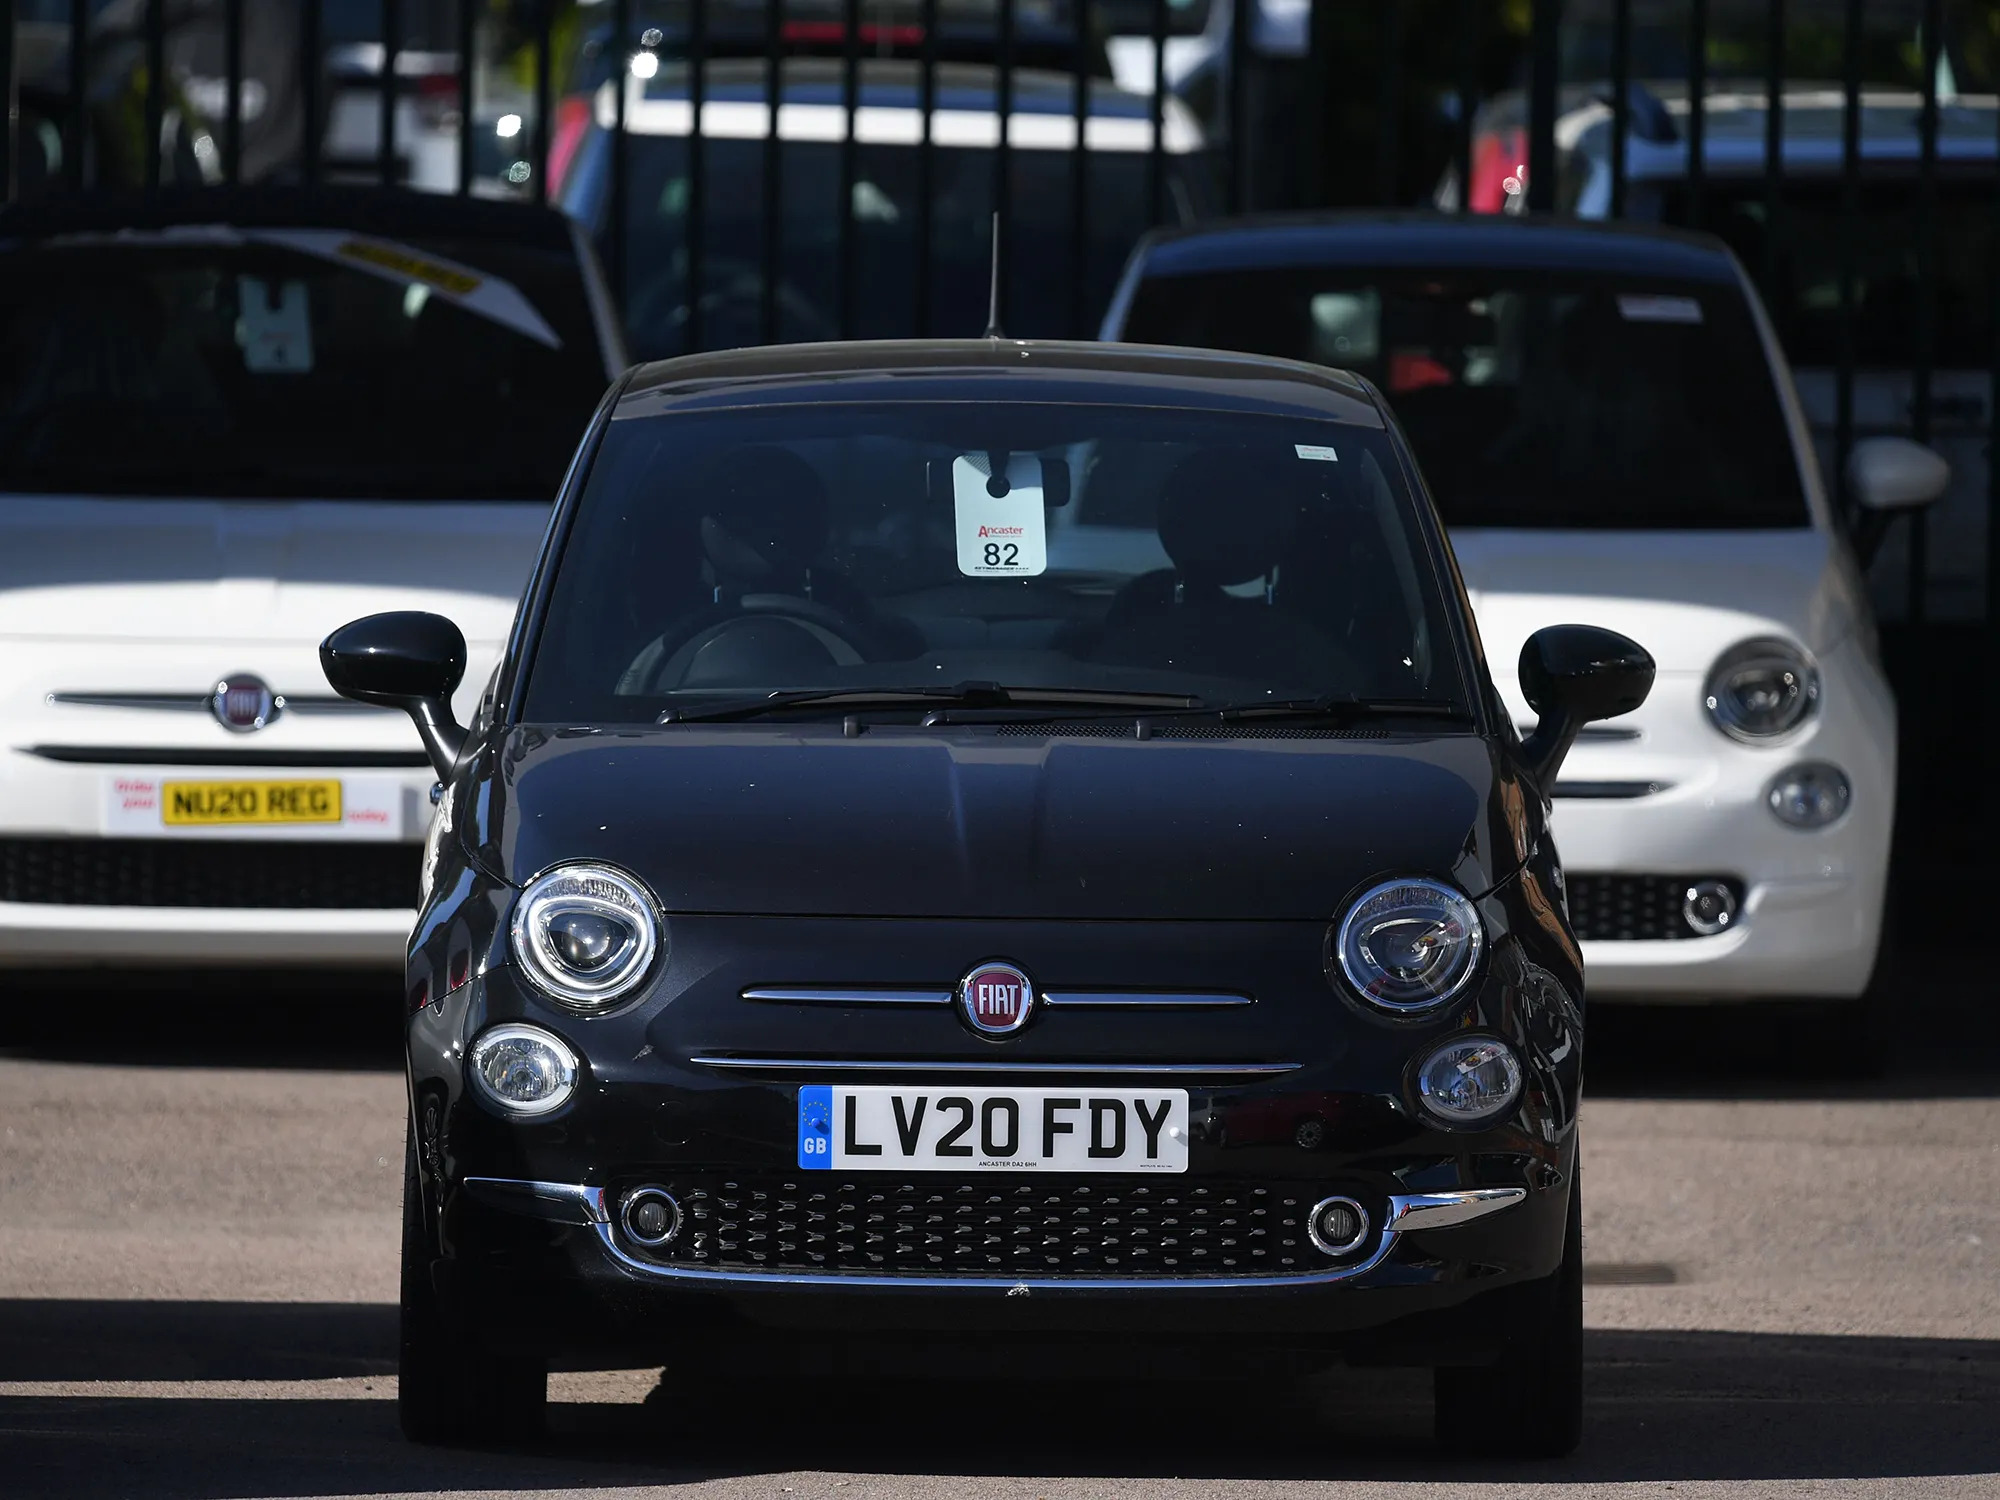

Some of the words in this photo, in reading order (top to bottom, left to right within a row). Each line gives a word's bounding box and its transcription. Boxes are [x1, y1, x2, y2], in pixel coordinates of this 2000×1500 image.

[978, 525, 1023, 537] Ancaster
[984, 543, 1019, 566] 82
[173, 786, 258, 816] NU20
[266, 786, 329, 815] REG
[979, 984, 1018, 1015] FIAT
[845, 1096, 1018, 1157] LV20
[1043, 1098, 1172, 1159] FDY
[804, 1138, 827, 1154] GB
